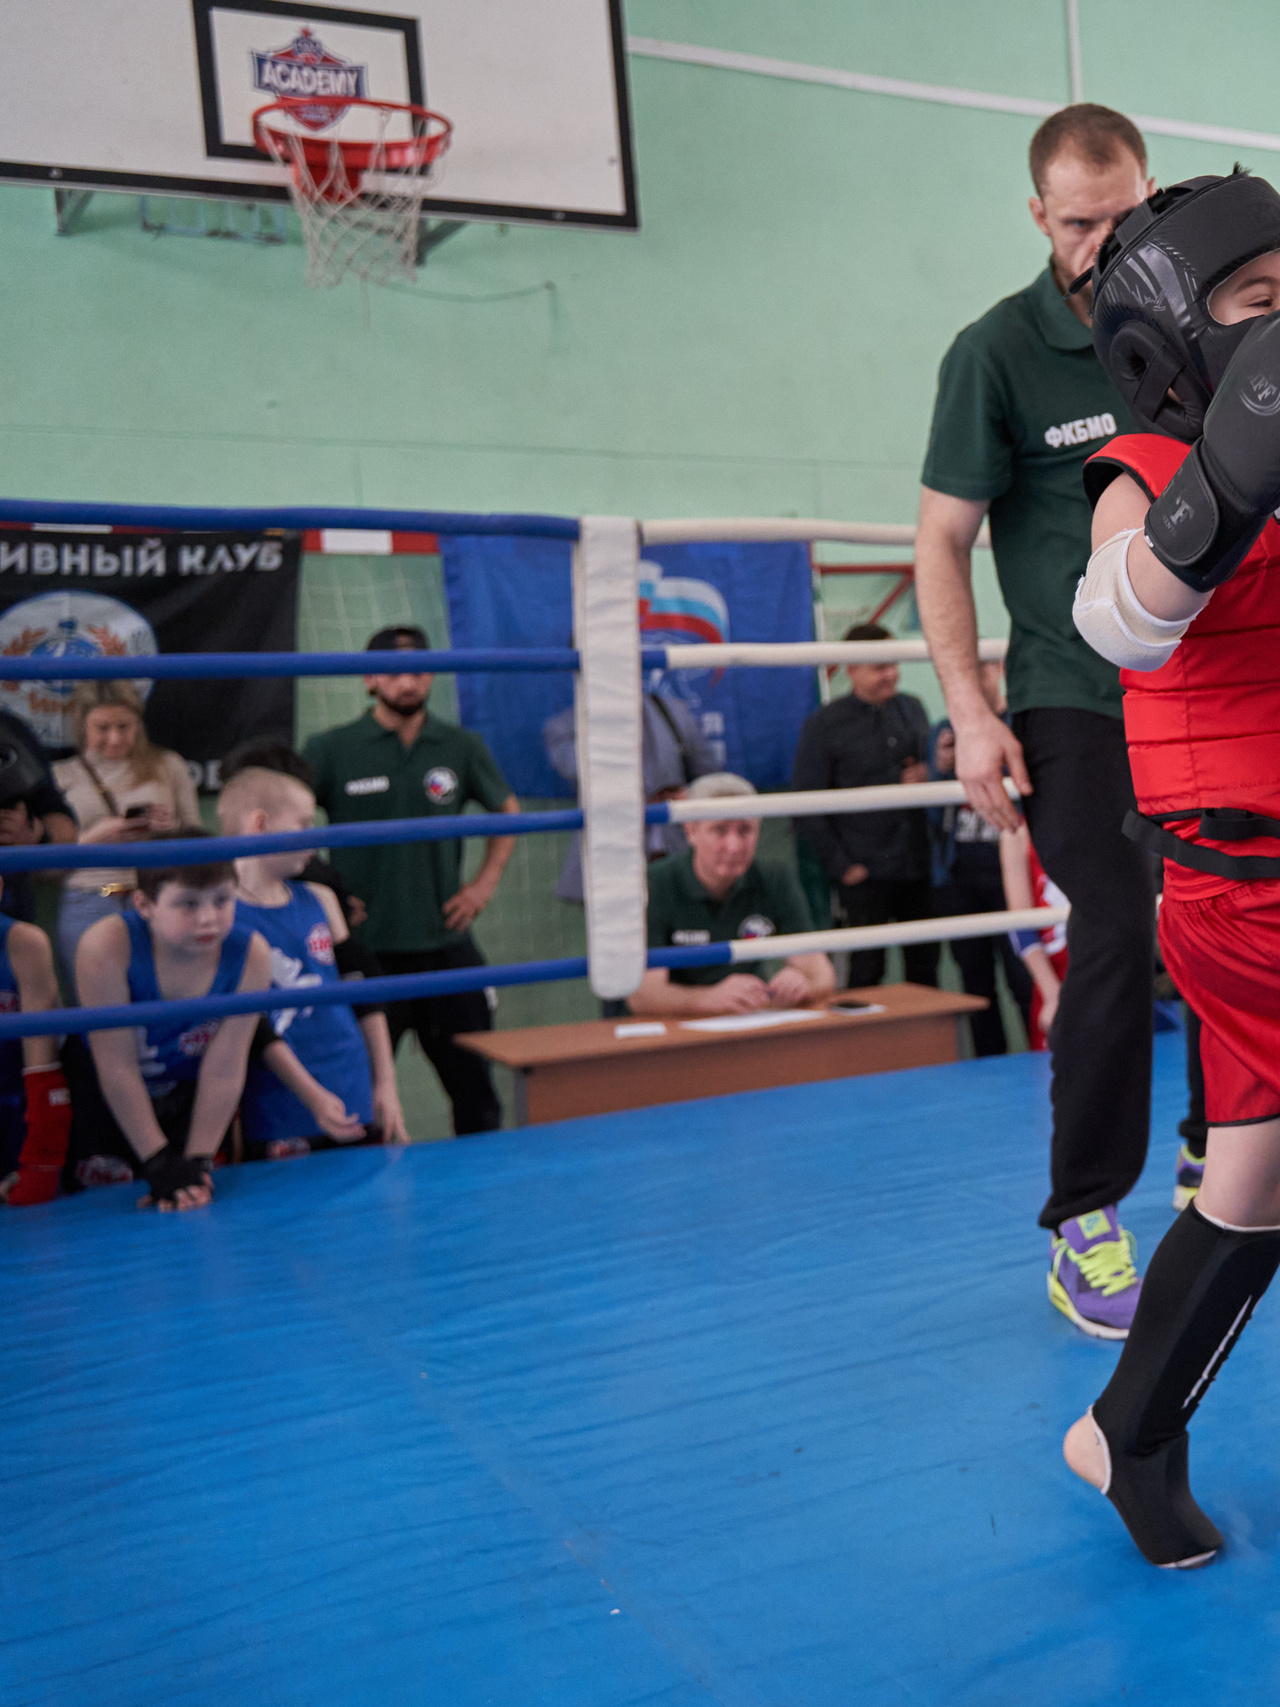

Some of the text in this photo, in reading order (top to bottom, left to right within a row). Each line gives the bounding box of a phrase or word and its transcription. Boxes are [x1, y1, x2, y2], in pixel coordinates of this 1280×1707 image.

[262, 61, 359, 96] ACADEMY
[1044, 412, 1117, 448] ФКБМО
[178, 542, 283, 574] КЛУБ
